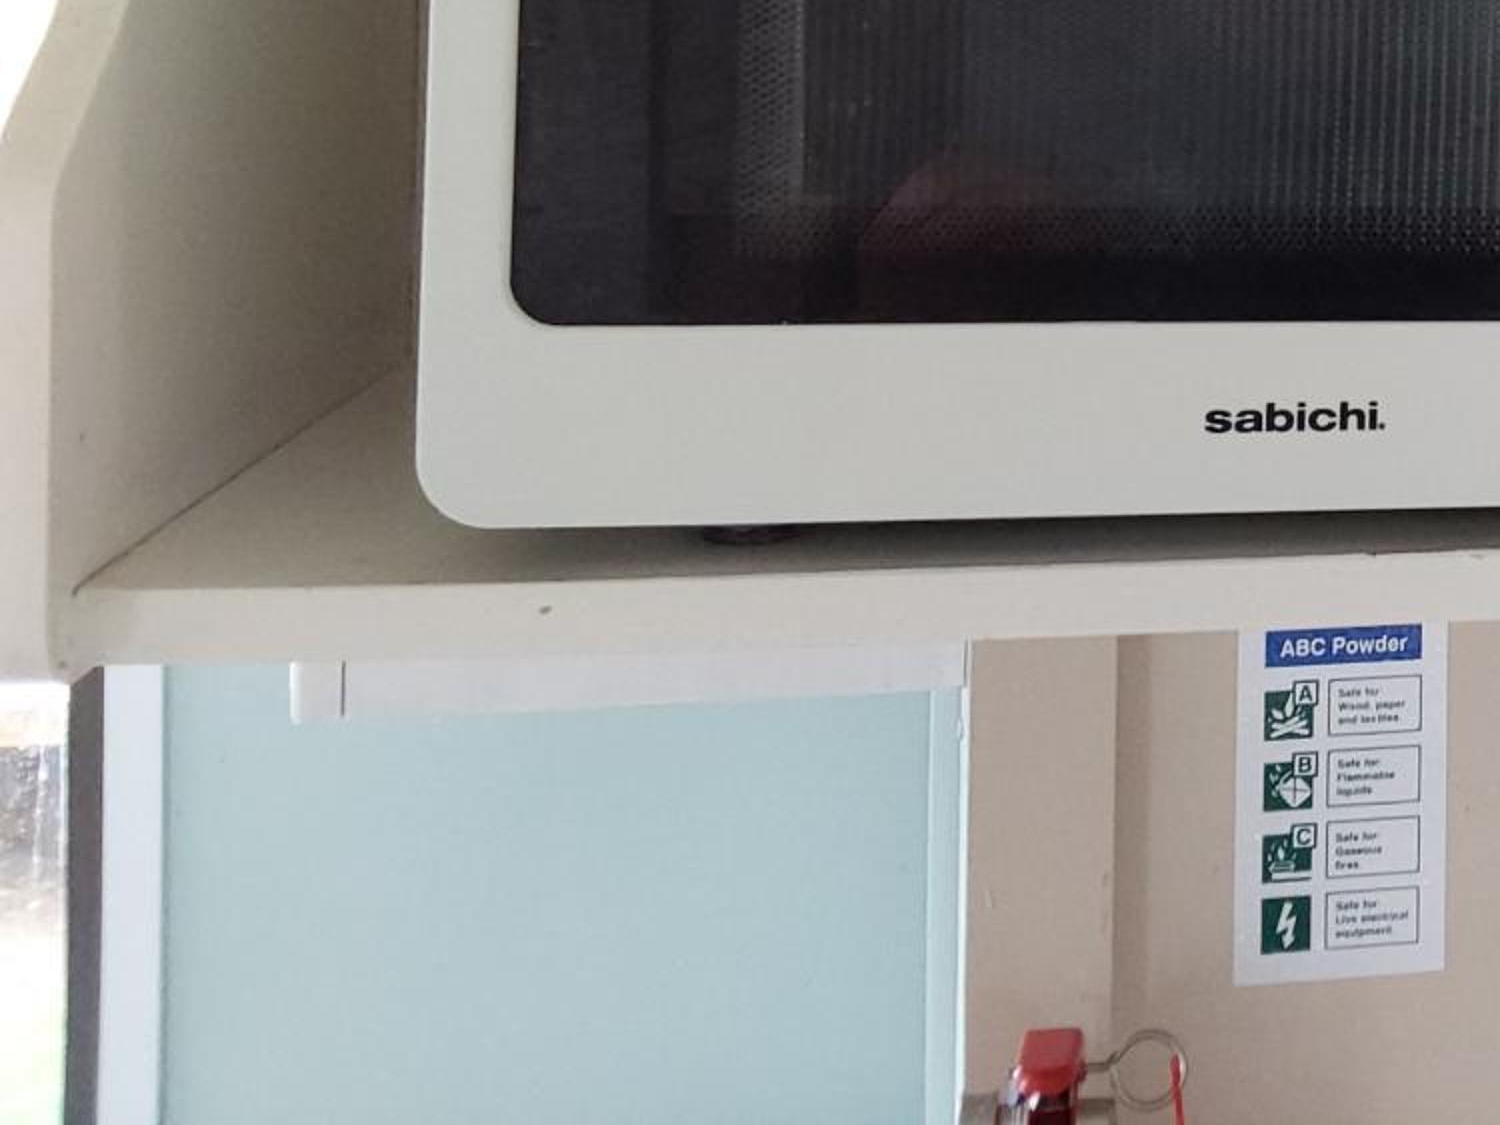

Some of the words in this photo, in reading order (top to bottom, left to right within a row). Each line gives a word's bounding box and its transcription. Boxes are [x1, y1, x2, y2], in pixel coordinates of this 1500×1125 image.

[1280, 638, 1326, 659] ABC
[1332, 635, 1409, 656] Powder
[1299, 684, 1313, 702] A
[1298, 757, 1312, 773] B
[1296, 828, 1312, 845] C
